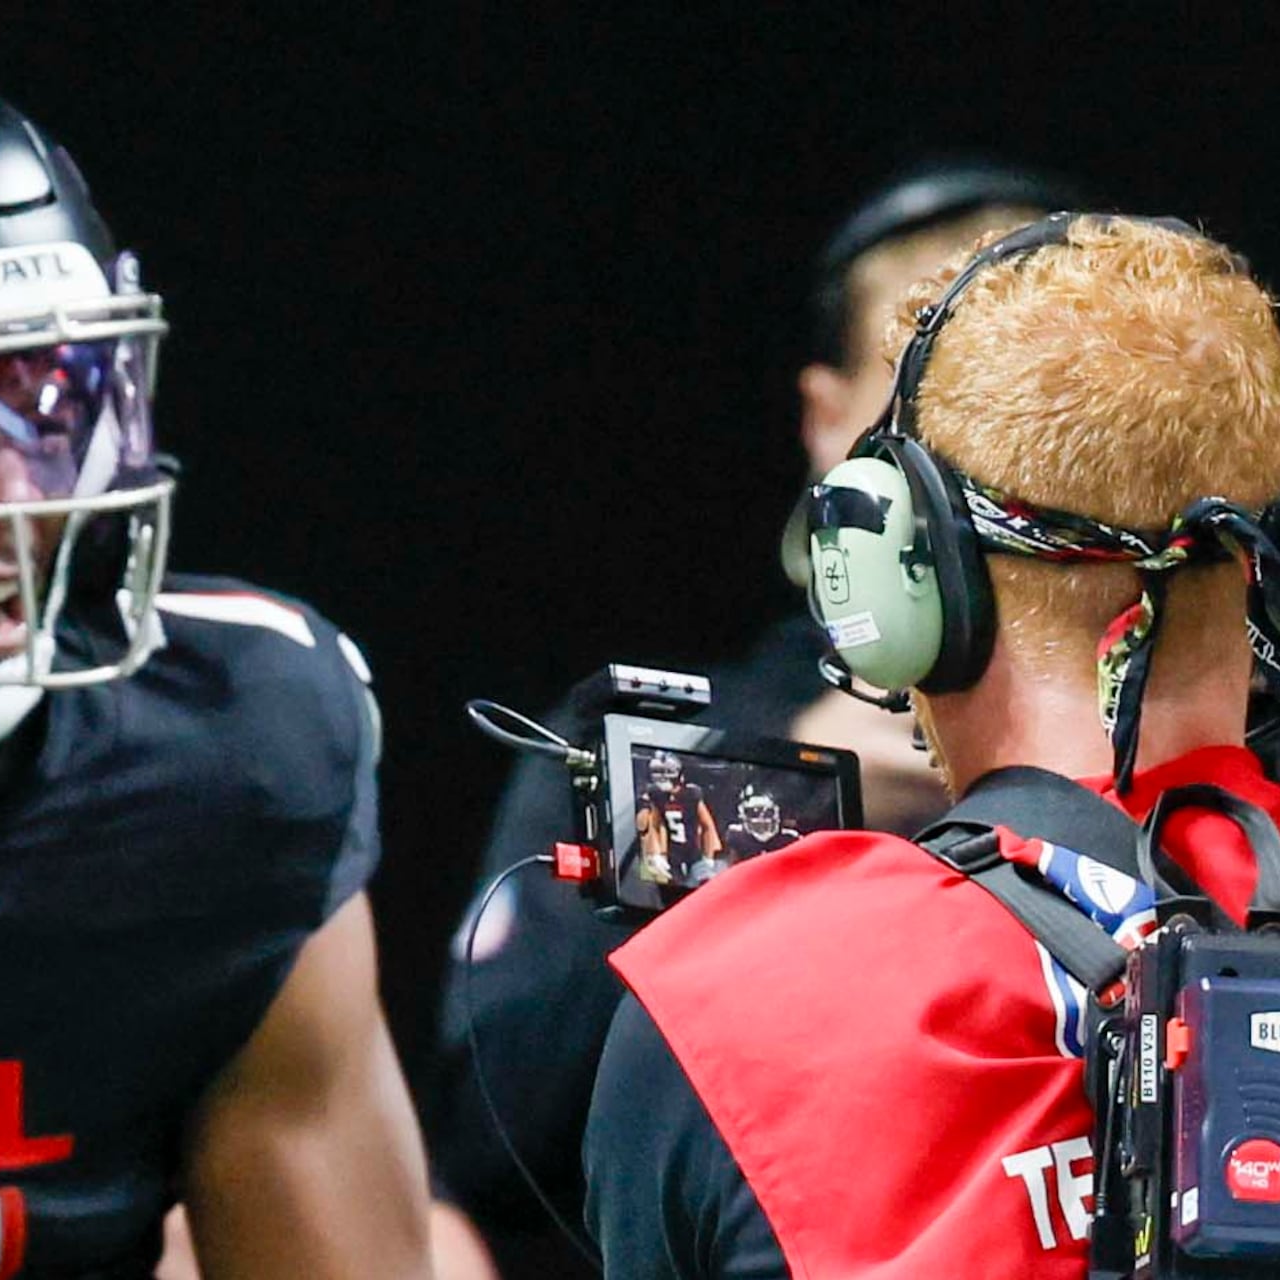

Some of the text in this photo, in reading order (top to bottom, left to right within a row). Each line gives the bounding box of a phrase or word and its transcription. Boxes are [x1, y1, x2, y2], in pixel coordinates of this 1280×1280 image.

[0, 253, 71, 285] ATL
[665, 810, 687, 844] 5
[1143, 1017, 1154, 1051] V3.0
